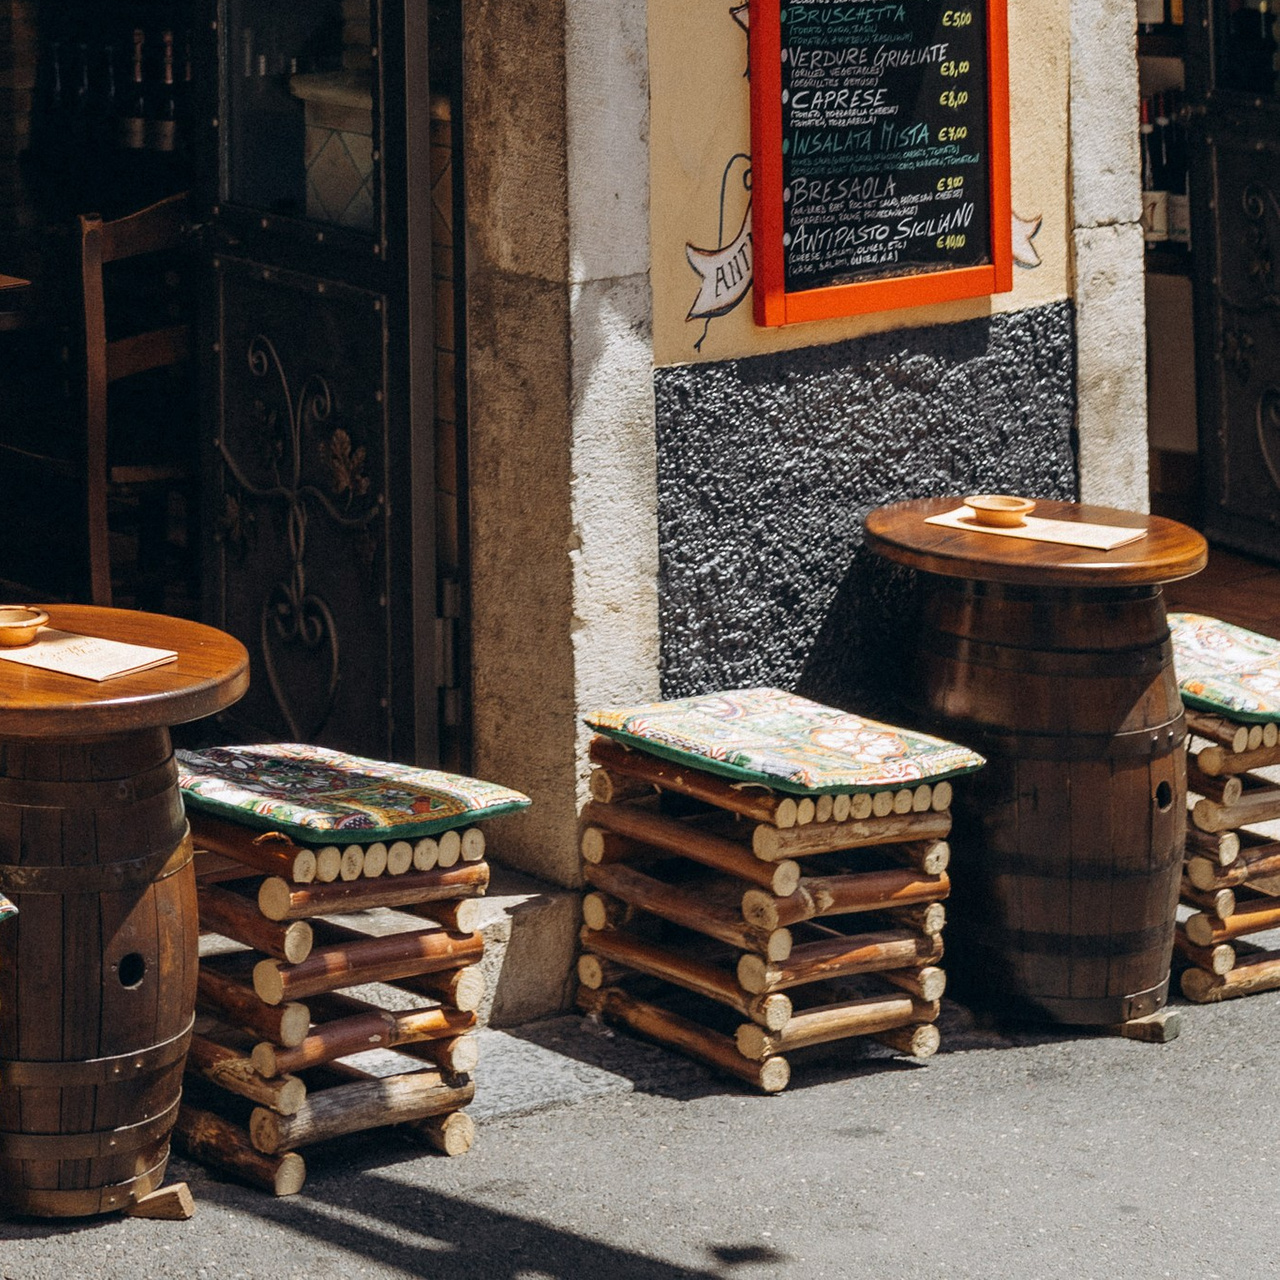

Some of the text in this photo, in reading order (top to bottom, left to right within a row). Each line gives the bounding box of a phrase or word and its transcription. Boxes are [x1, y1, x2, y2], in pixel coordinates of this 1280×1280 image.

[787, 4, 972, 27] BRUSCHETTA €5,00
[788, 43, 970, 77] VERDURE GRIGLIATE €8,00
[791, 88, 969, 109] CAPRESE €8,00
[792, 129, 872, 157] INSALATA
[880, 120, 930, 151] MISTA
[790, 174, 896, 207] BRESAOLA
[790, 202, 974, 253] ANTIPASTO SICILIANO
